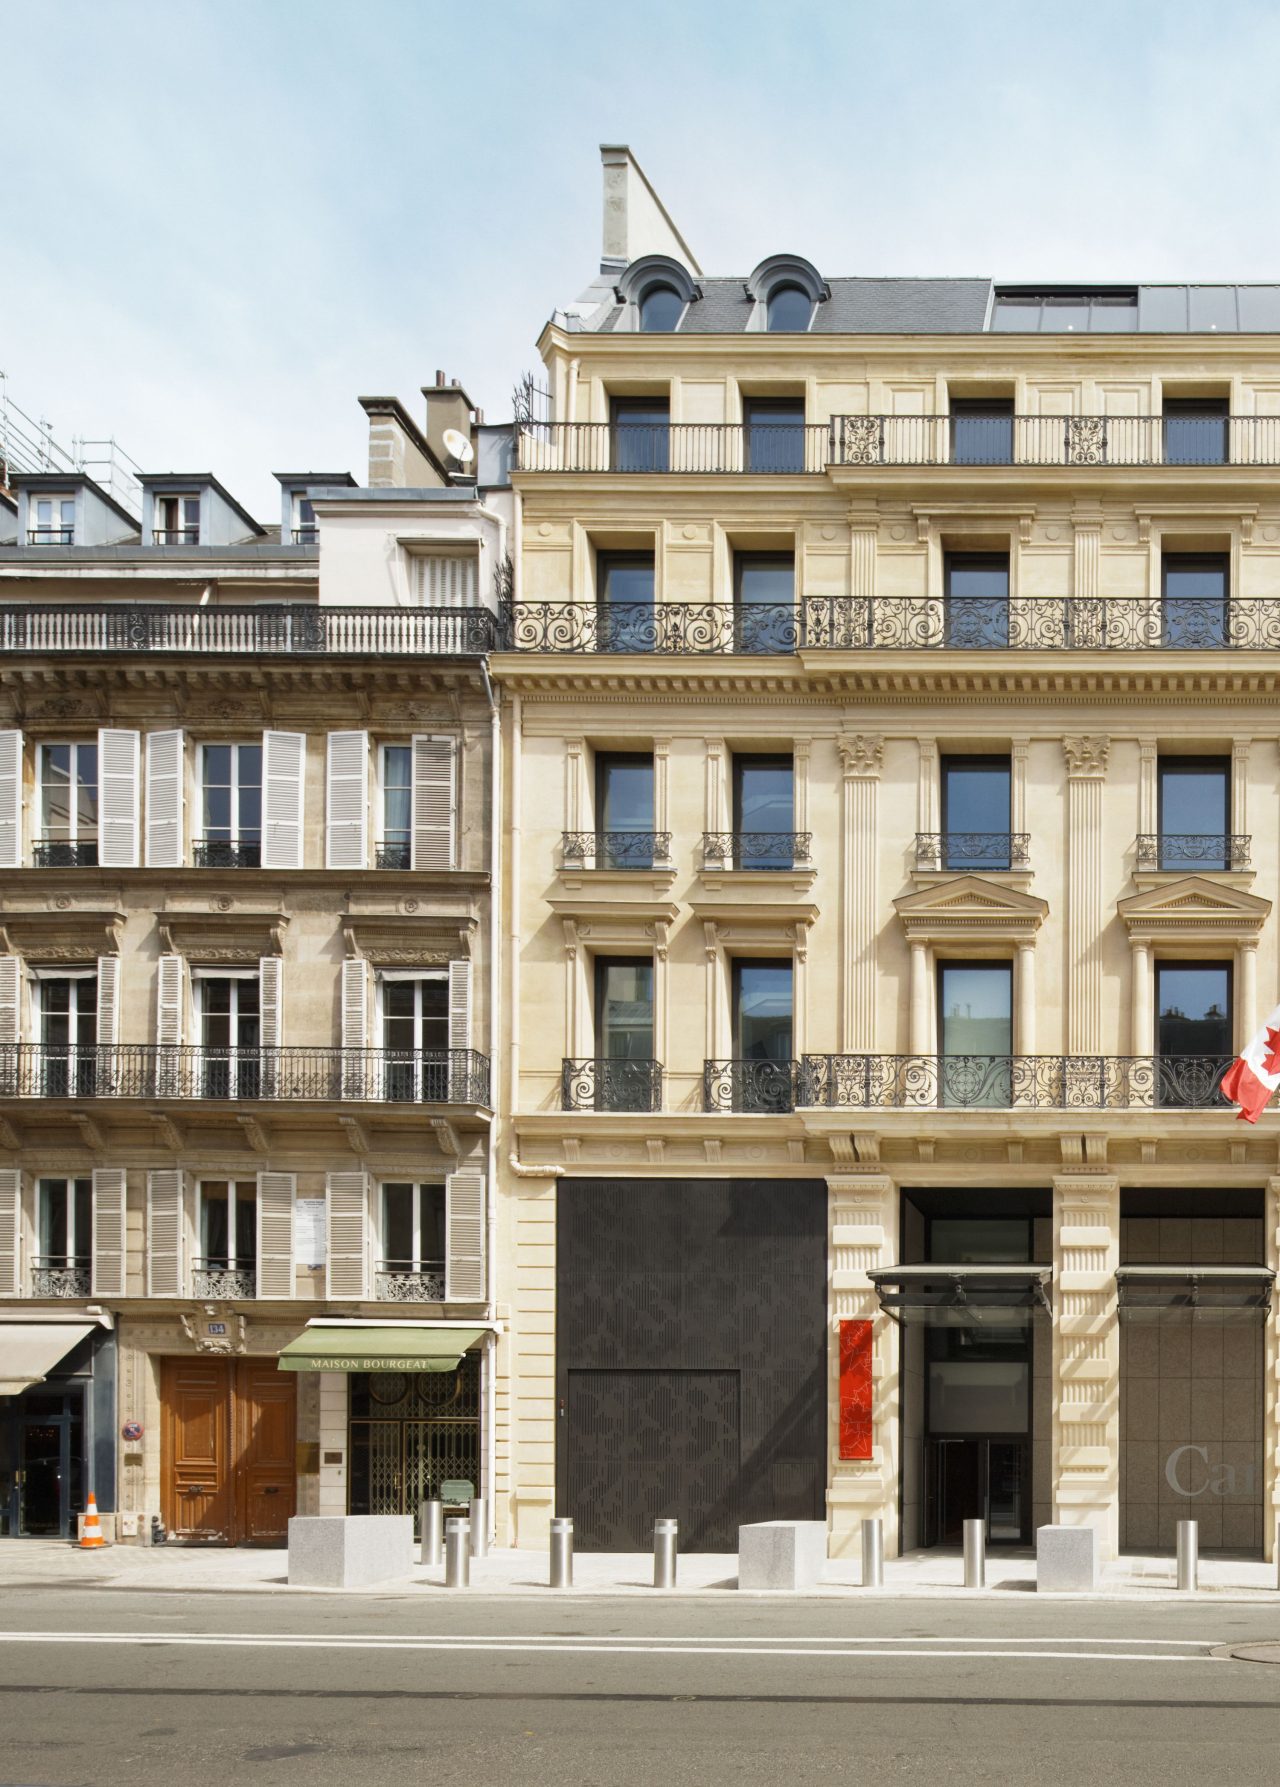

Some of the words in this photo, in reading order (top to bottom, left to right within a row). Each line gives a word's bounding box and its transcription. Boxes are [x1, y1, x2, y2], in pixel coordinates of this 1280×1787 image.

[209, 1324, 225, 1334] 134
[311, 1359, 359, 1369] MAISON
[363, 1359, 429, 1370] BOURGEAT
